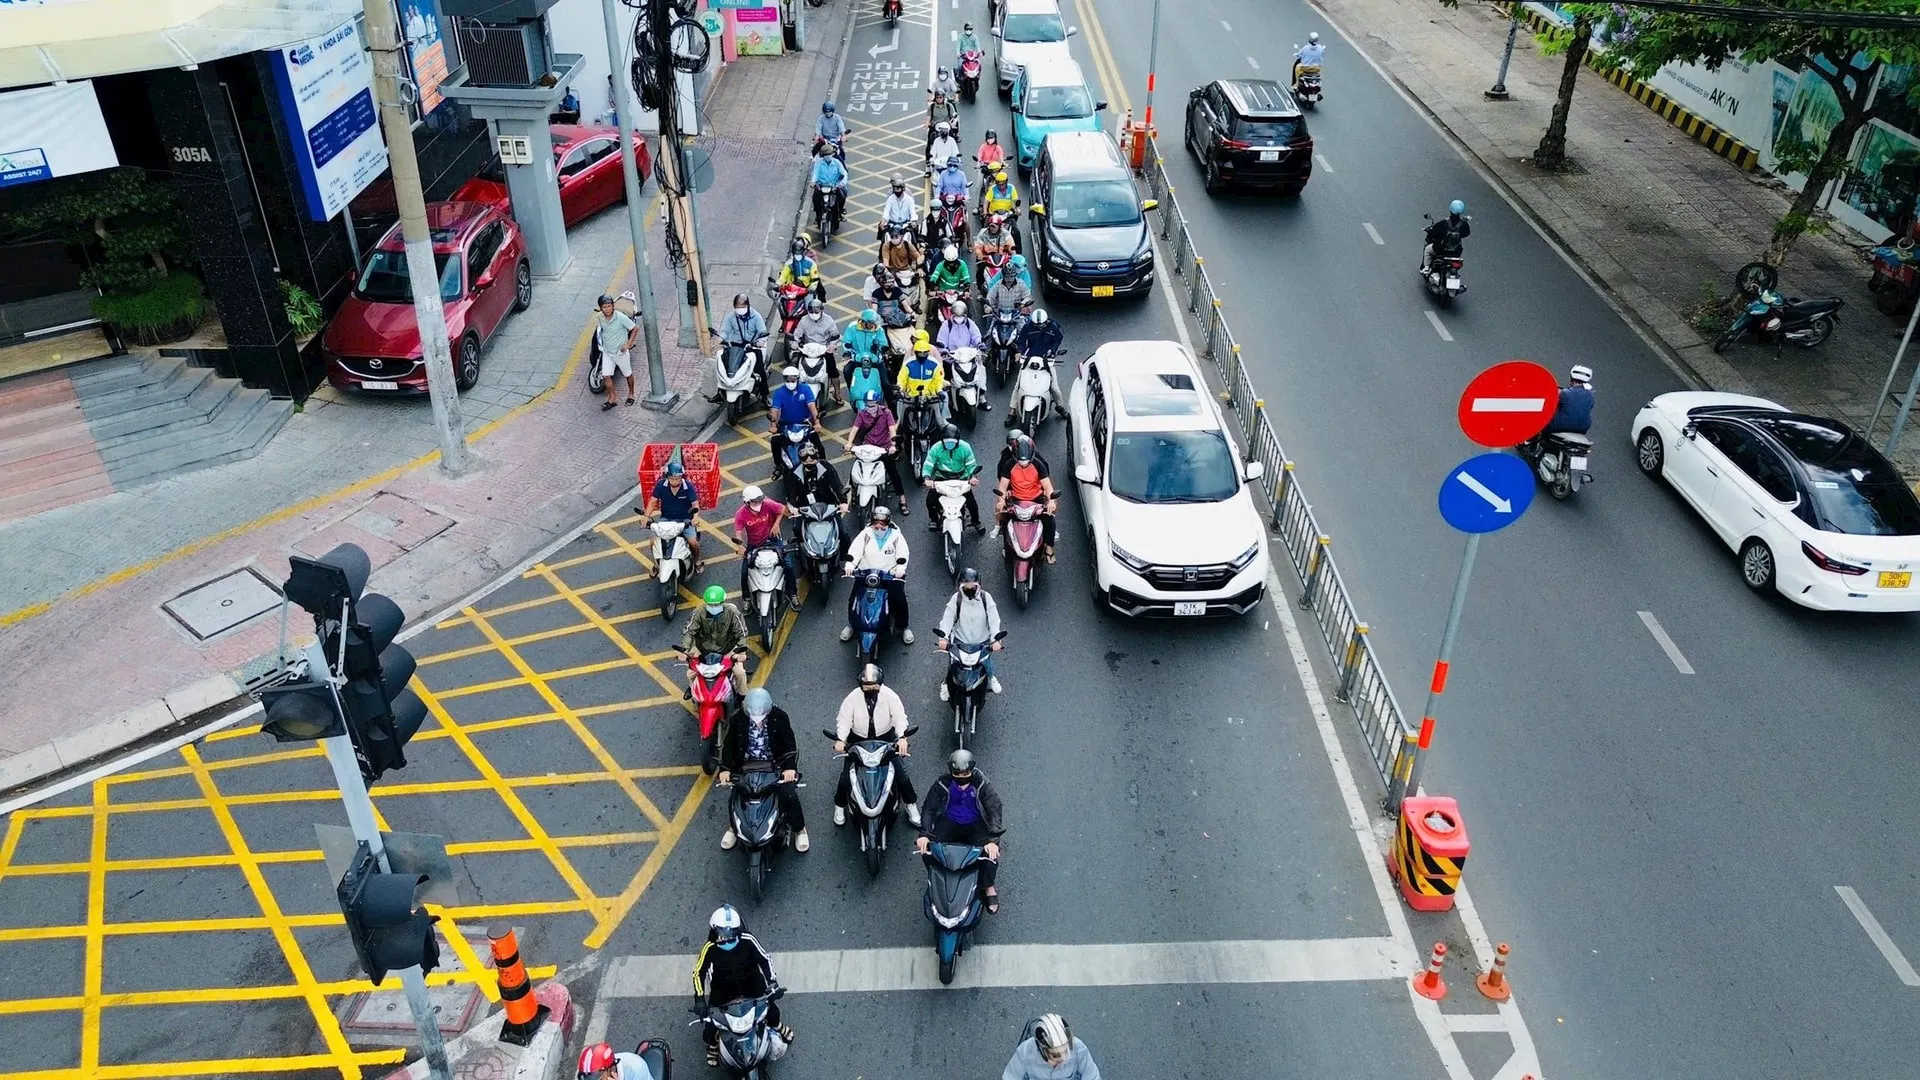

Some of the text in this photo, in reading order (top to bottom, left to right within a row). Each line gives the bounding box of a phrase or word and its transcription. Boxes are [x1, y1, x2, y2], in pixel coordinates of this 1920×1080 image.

[323, 36, 337, 50] KHOA
[299, 51, 315, 66] MEDIC
[172, 146, 213, 163] 305A
[3, 169, 42, 181] ASSIST 24/7
